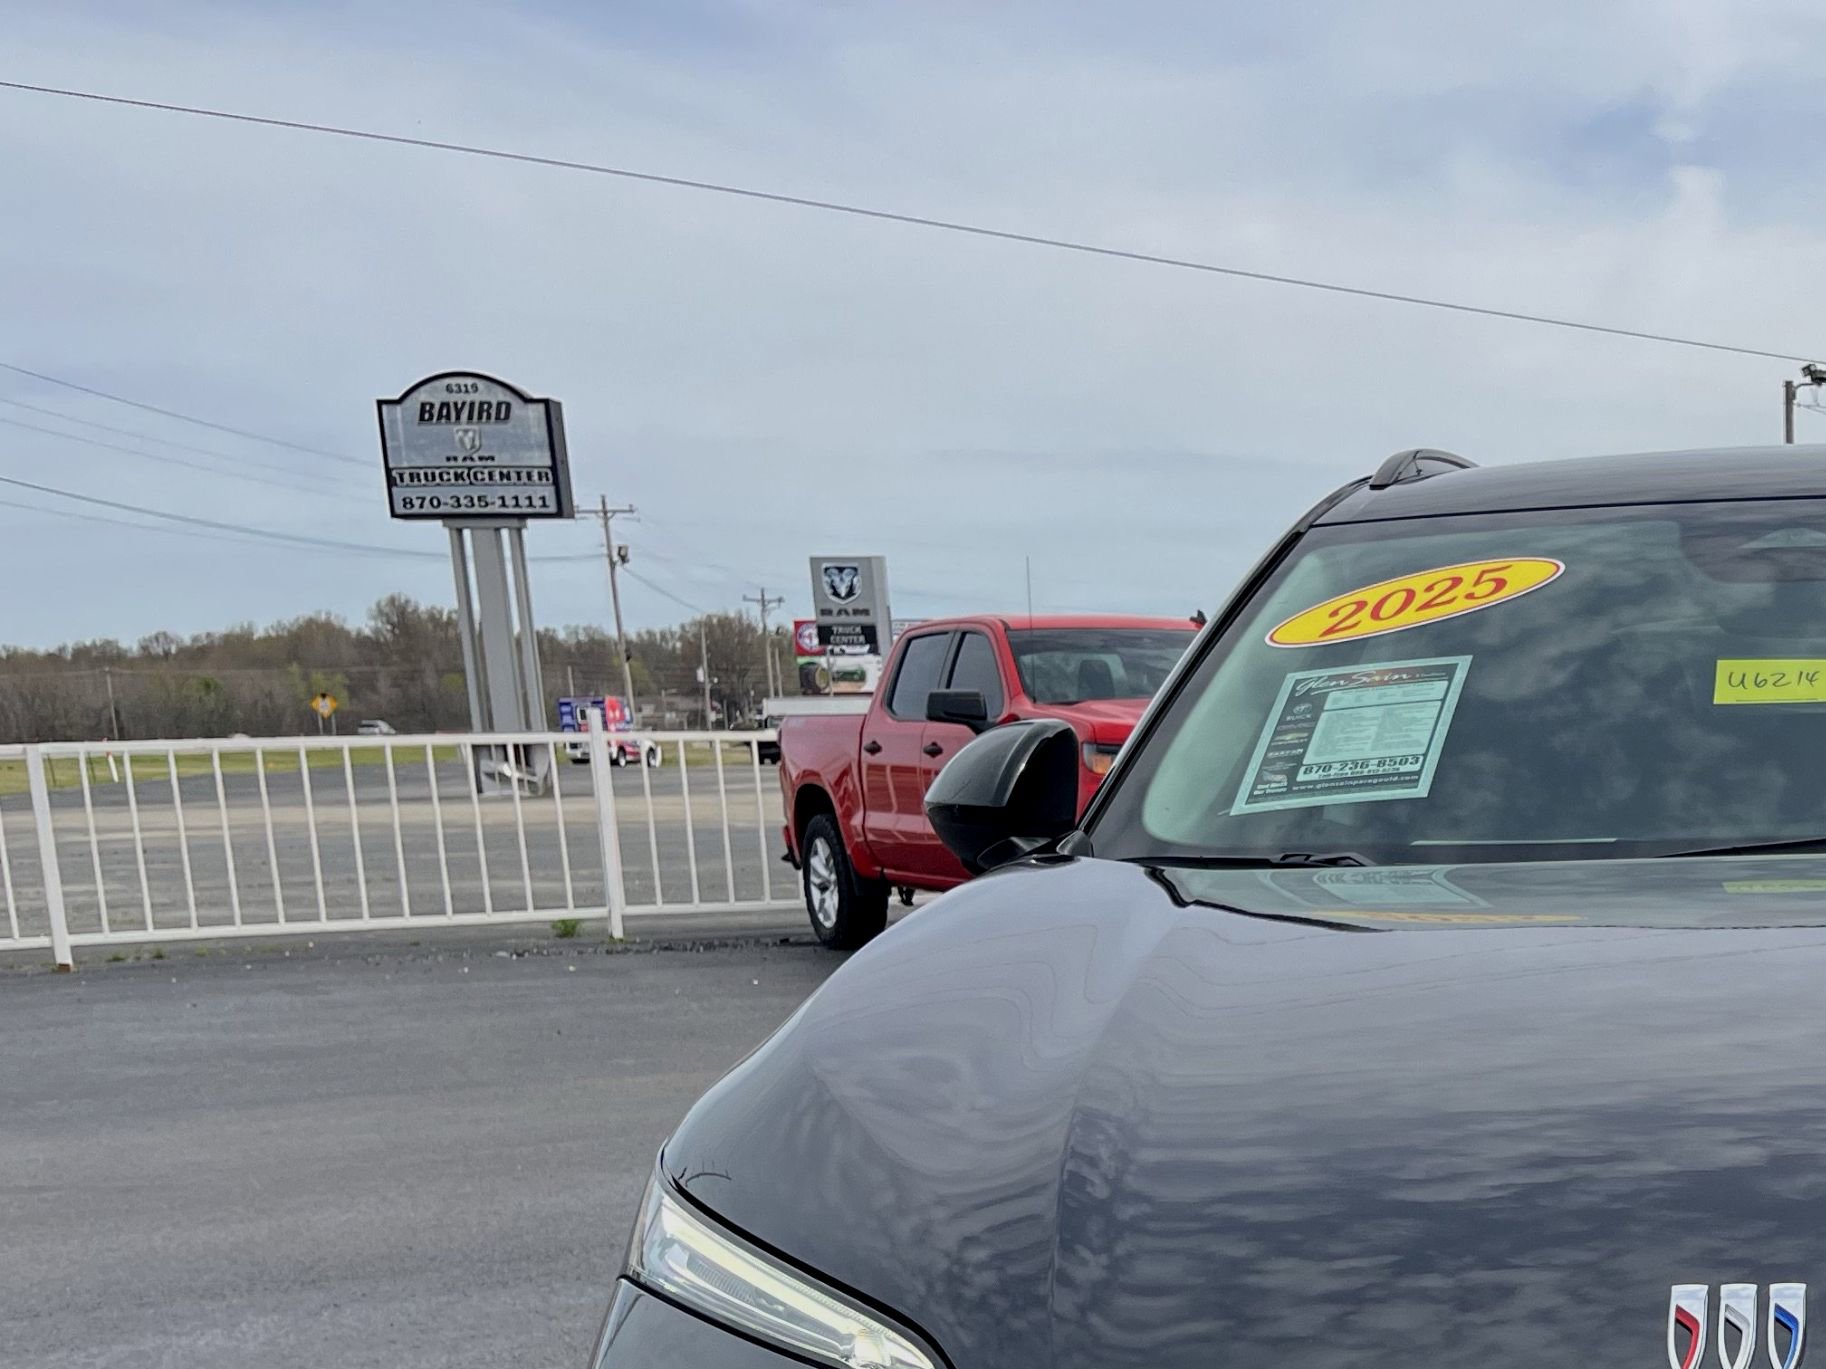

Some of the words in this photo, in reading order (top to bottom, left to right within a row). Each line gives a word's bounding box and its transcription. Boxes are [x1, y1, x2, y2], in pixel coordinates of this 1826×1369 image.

[417, 400, 512, 424] BAYIRD
[445, 455, 496, 463] RAM
[394, 470, 469, 484] TRUCK
[471, 470, 552, 483] CENTER
[401, 495, 551, 510] 870-335-1111
[1318, 564, 1514, 639] 2025
[820, 607, 871, 617] RAM
[831, 625, 862, 635] TRUCK
[830, 635, 866, 645] CENTER
[1302, 756, 1421, 775] 870-236-8503
